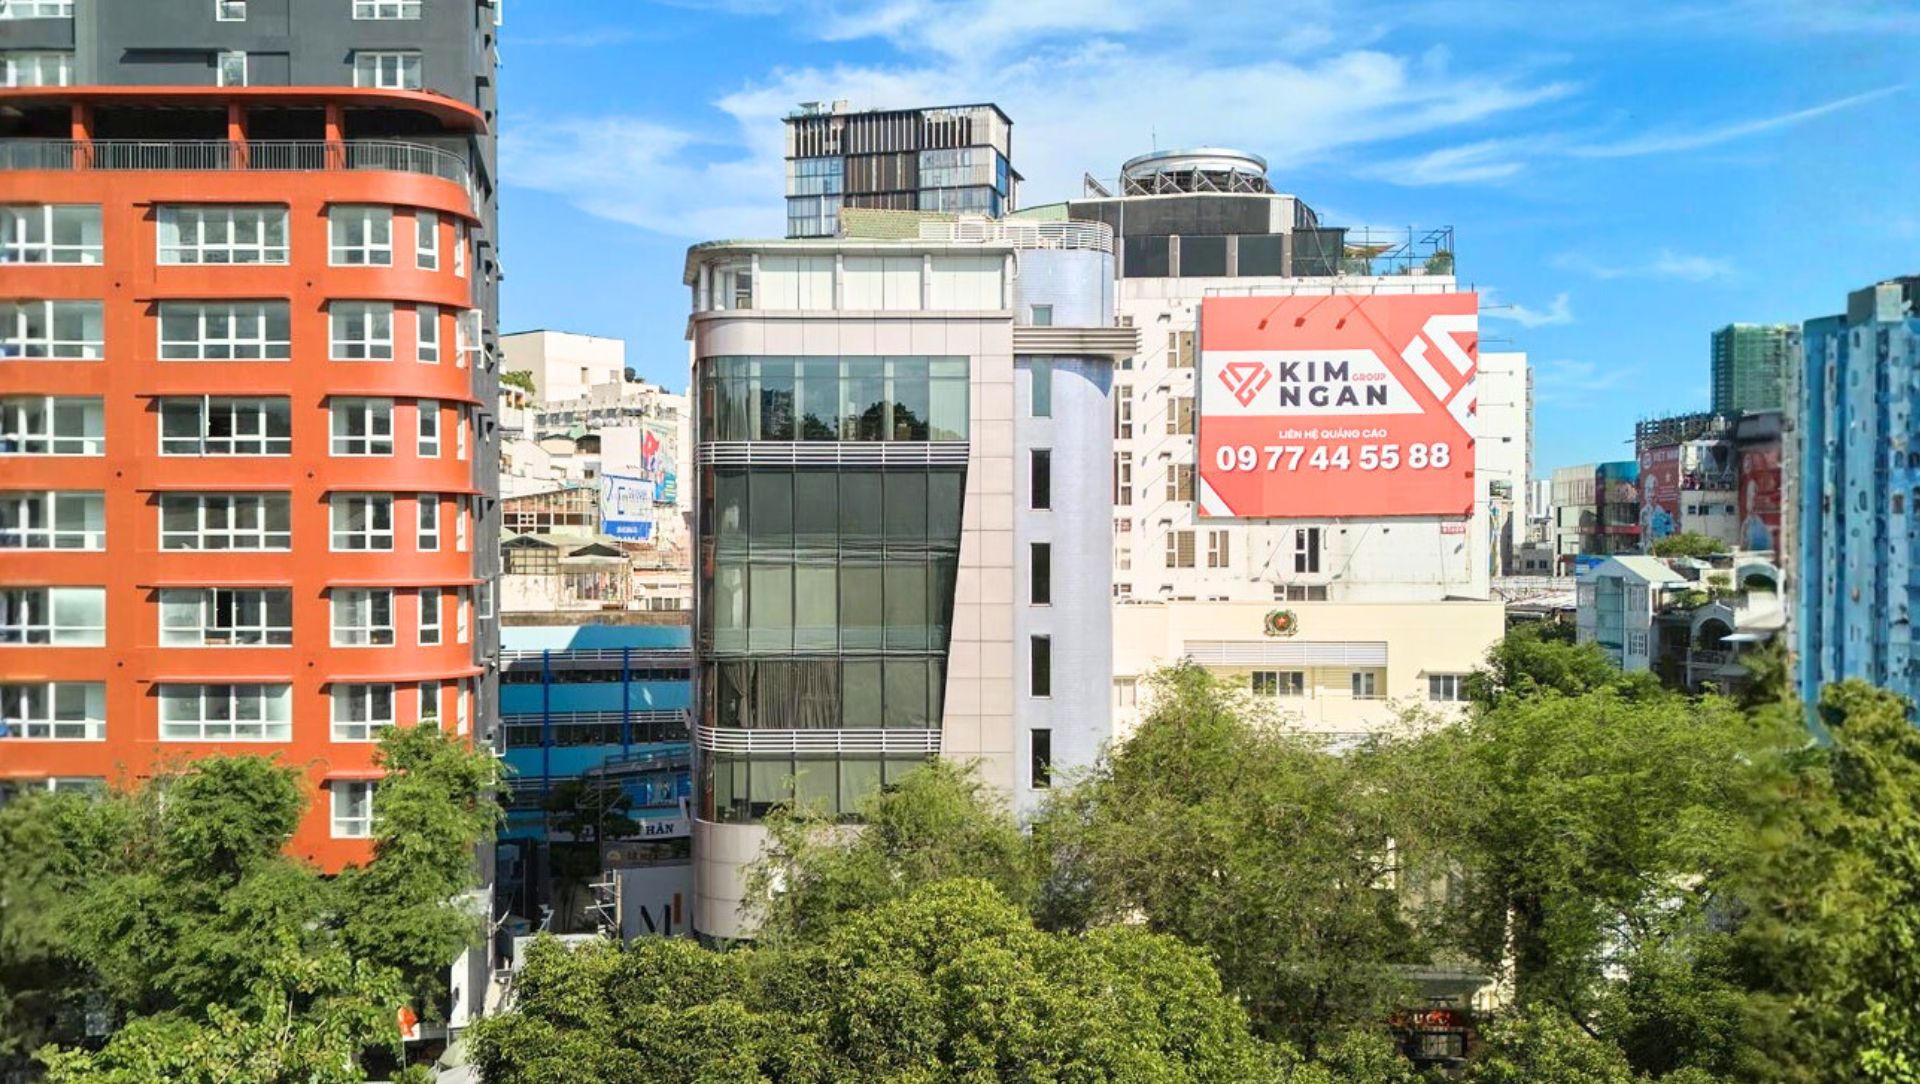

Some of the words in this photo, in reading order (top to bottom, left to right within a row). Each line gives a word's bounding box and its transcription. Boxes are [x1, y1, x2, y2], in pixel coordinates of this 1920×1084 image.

[1280, 361, 1349, 382] KIM
[1352, 373, 1387, 382] GROUP
[1280, 385, 1388, 407] NGAN
[1216, 446, 1257, 471] 09
[1264, 446, 1305, 471] 77
[1309, 445, 1350, 470] 44
[1359, 444, 1400, 470] 55
[1408, 443, 1450, 469] 88
